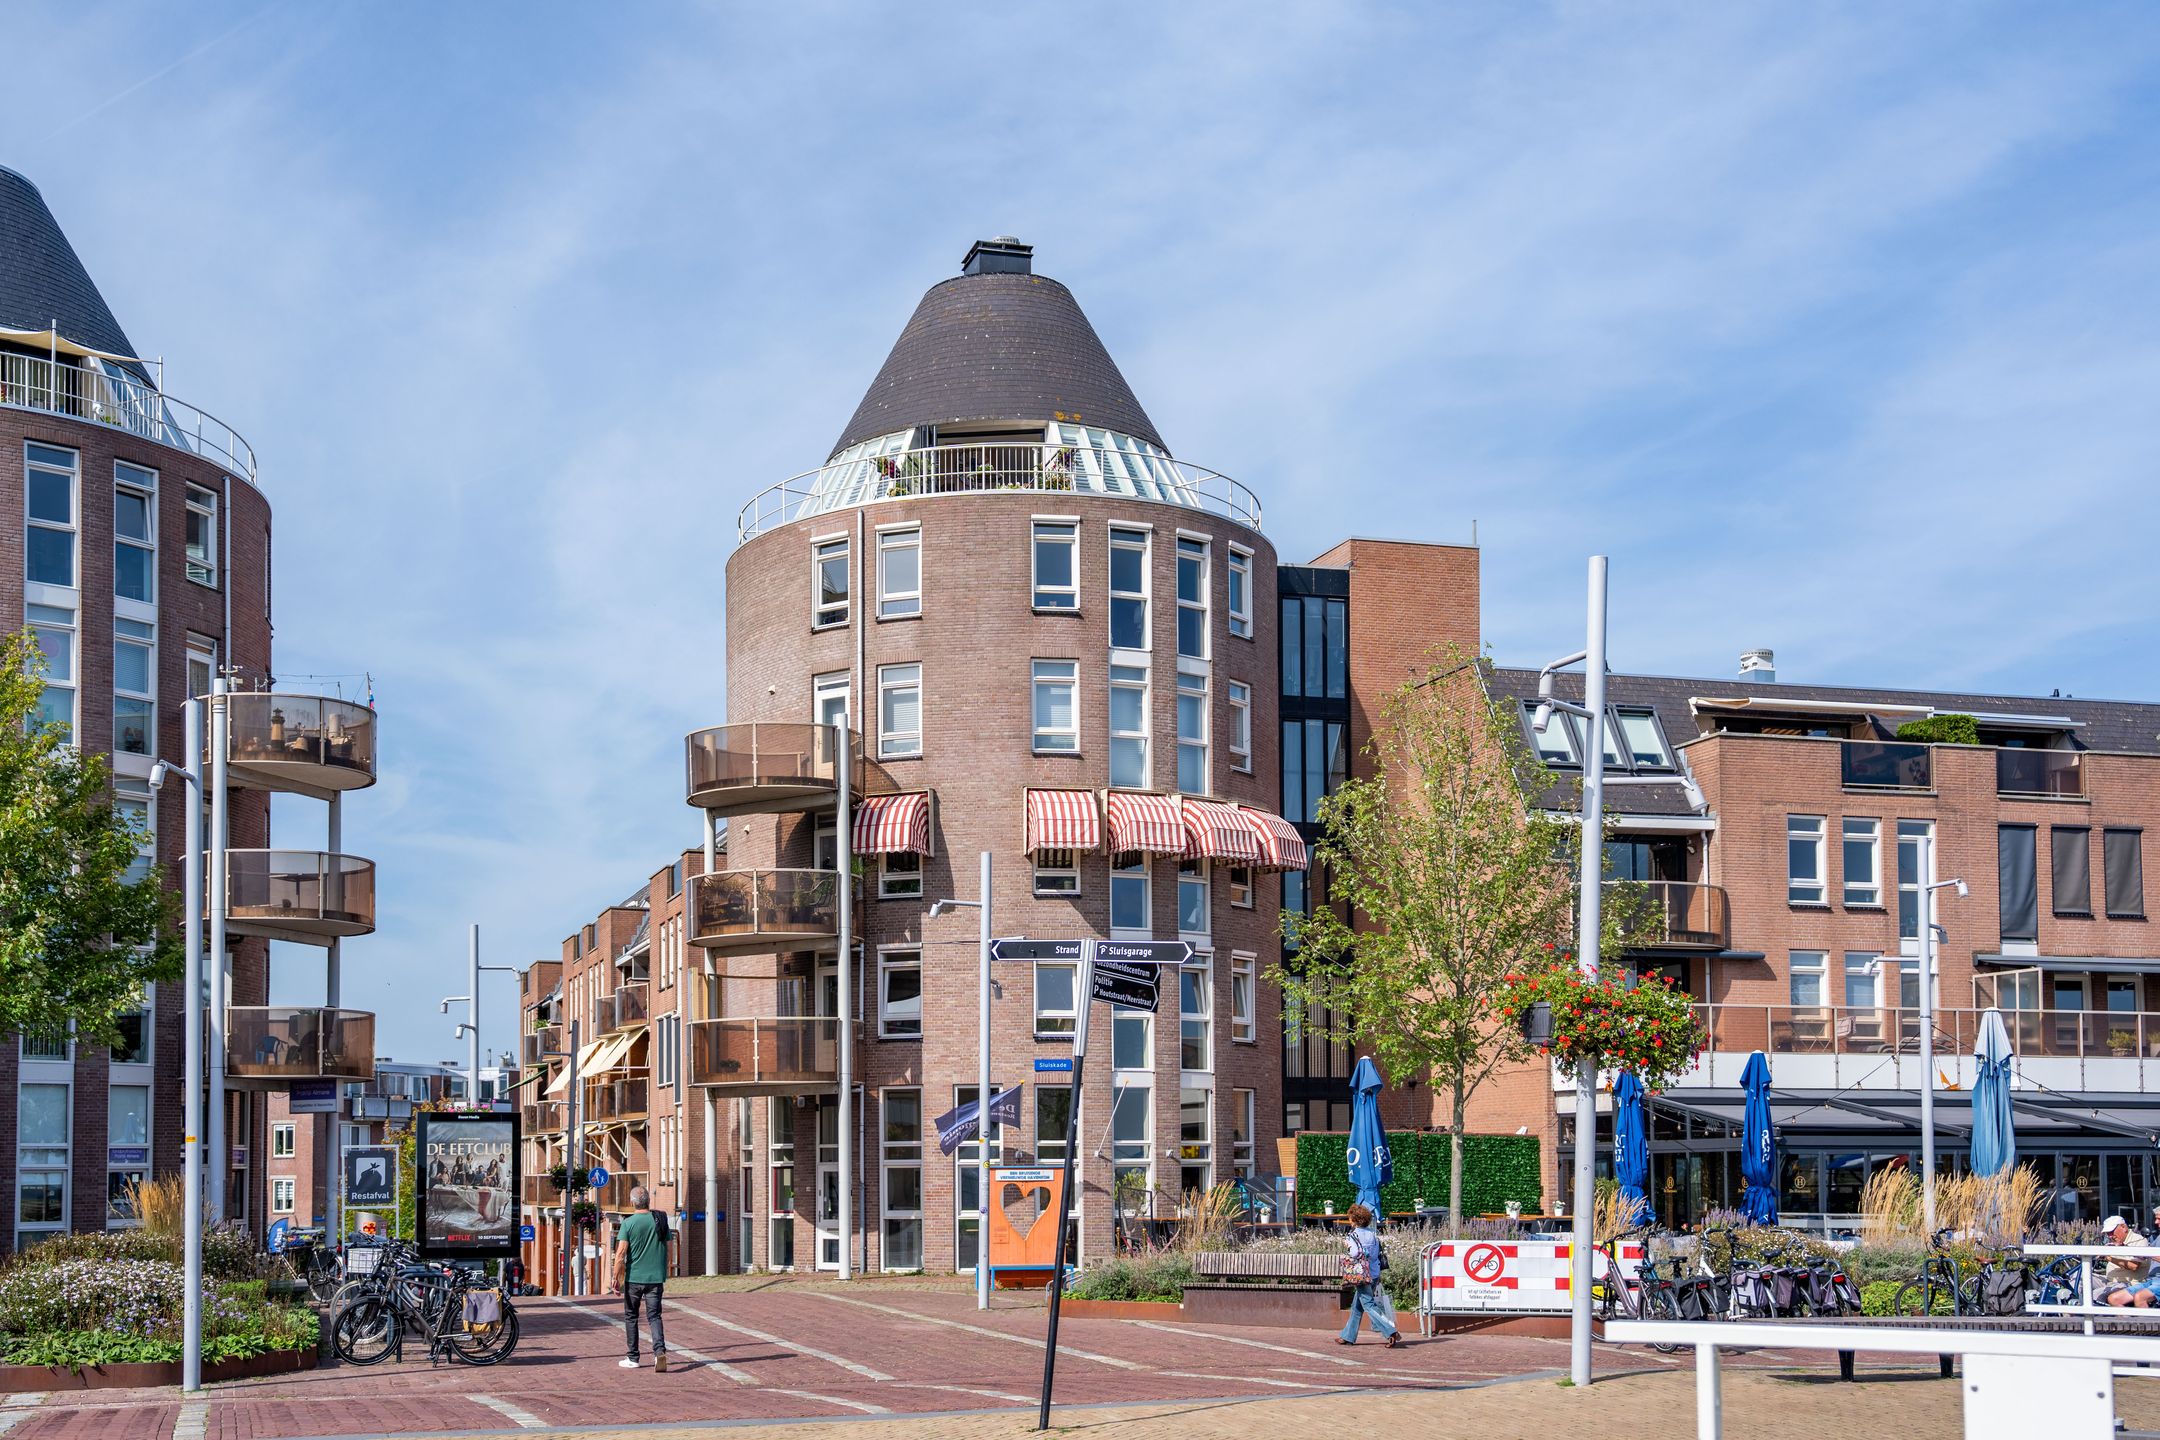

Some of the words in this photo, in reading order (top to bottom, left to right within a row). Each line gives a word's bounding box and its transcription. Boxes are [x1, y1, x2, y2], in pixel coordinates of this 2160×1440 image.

[1055, 945, 1079, 954] Strand
[1108, 944, 1153, 958] Sluisgarage
[1094, 975, 1113, 987] Politie
[1093, 984, 1100, 995] P
[1099, 988, 1152, 1007] Houtstraat/Meerstraat
[426, 1143, 446, 1156] DE
[449, 1142, 512, 1156] EETCLUB
[351, 1191, 390, 1200] Restafval
[447, 1234, 471, 1242] NETFLIX
